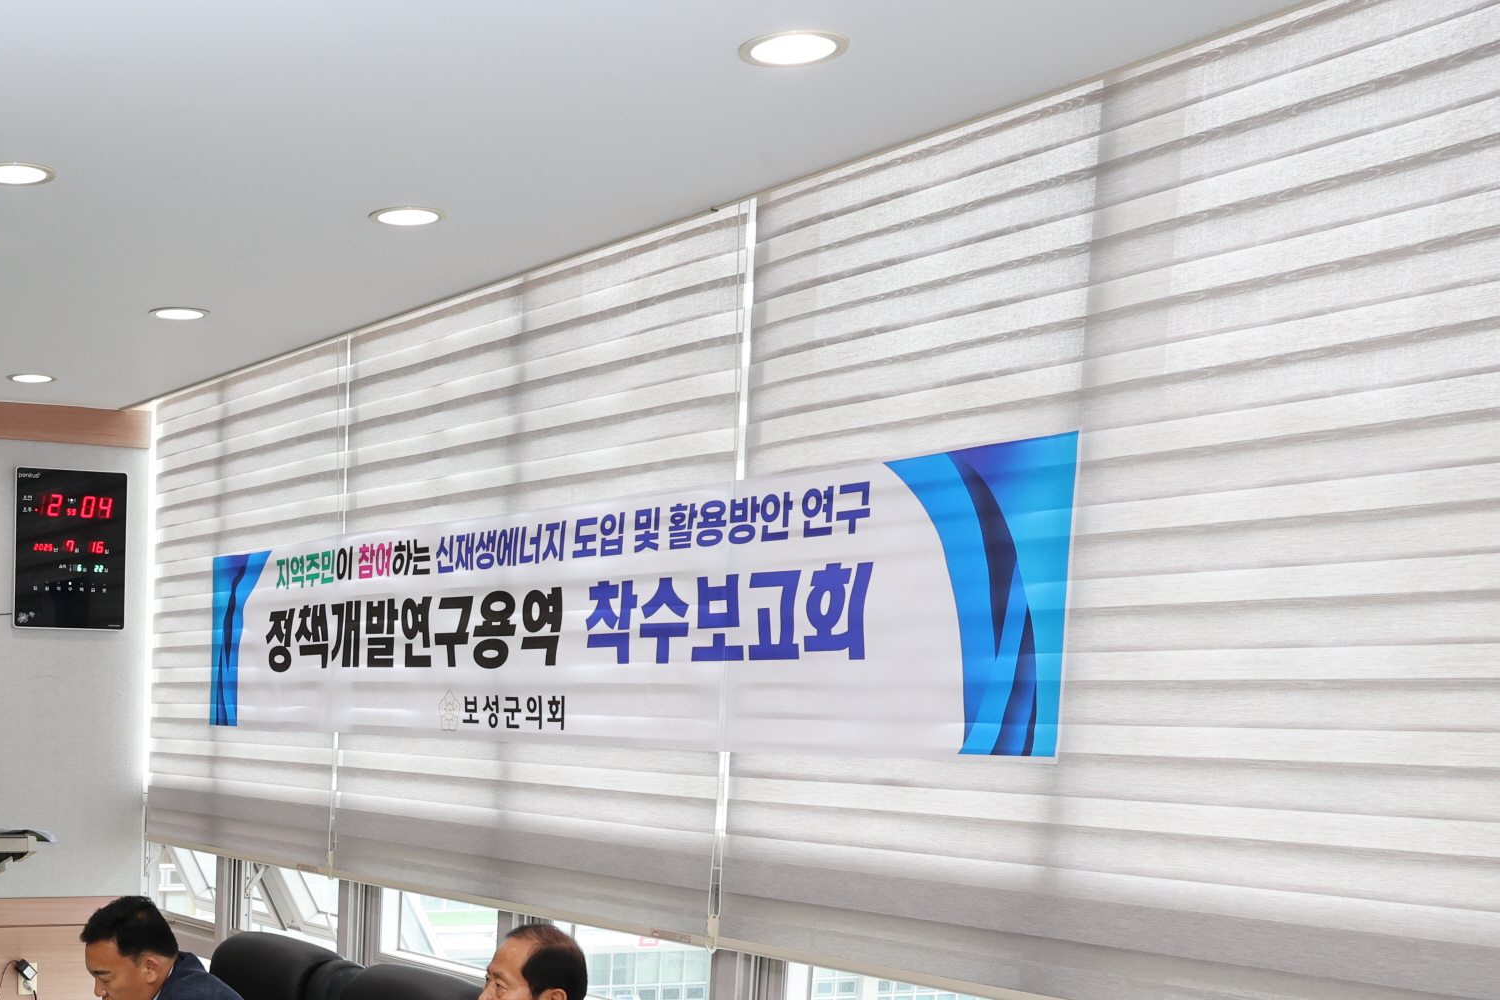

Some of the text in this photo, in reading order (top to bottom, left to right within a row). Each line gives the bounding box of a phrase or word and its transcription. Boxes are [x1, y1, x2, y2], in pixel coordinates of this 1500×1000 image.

[80, 495, 113, 519] 04
[276, 481, 871, 590] 지역주민이 참여하는 신재생에너지 도입 및 활용방안 연구
[266, 561, 874, 673] 정책개발연구용역 착수보고회
[462, 694, 565, 730] 보성군의회
